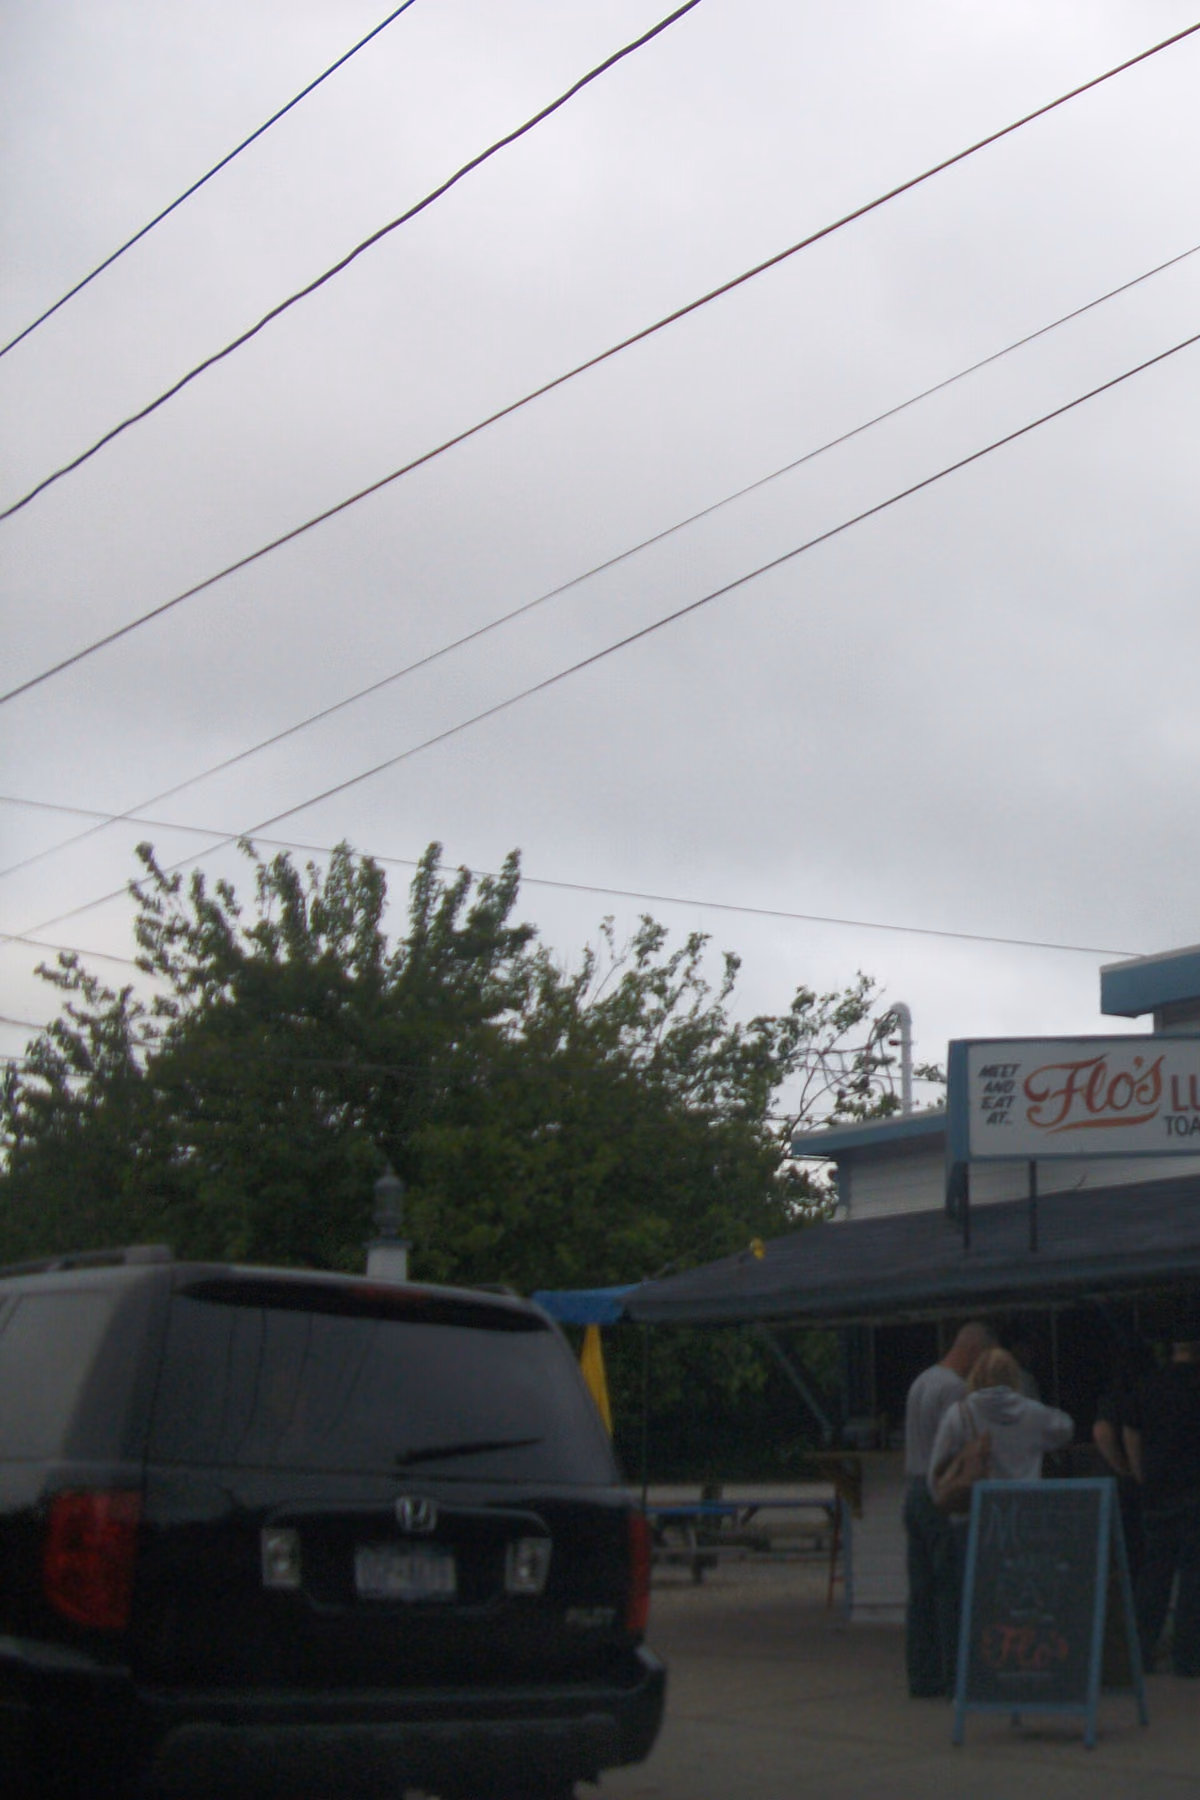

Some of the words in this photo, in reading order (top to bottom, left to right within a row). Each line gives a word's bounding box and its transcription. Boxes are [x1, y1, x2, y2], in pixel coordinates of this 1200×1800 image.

[978, 1063, 1022, 1078] MEET
[983, 1080, 1015, 1093] AND
[1023, 1052, 1166, 1129] Flo's
[980, 1095, 1016, 1109] EAT
